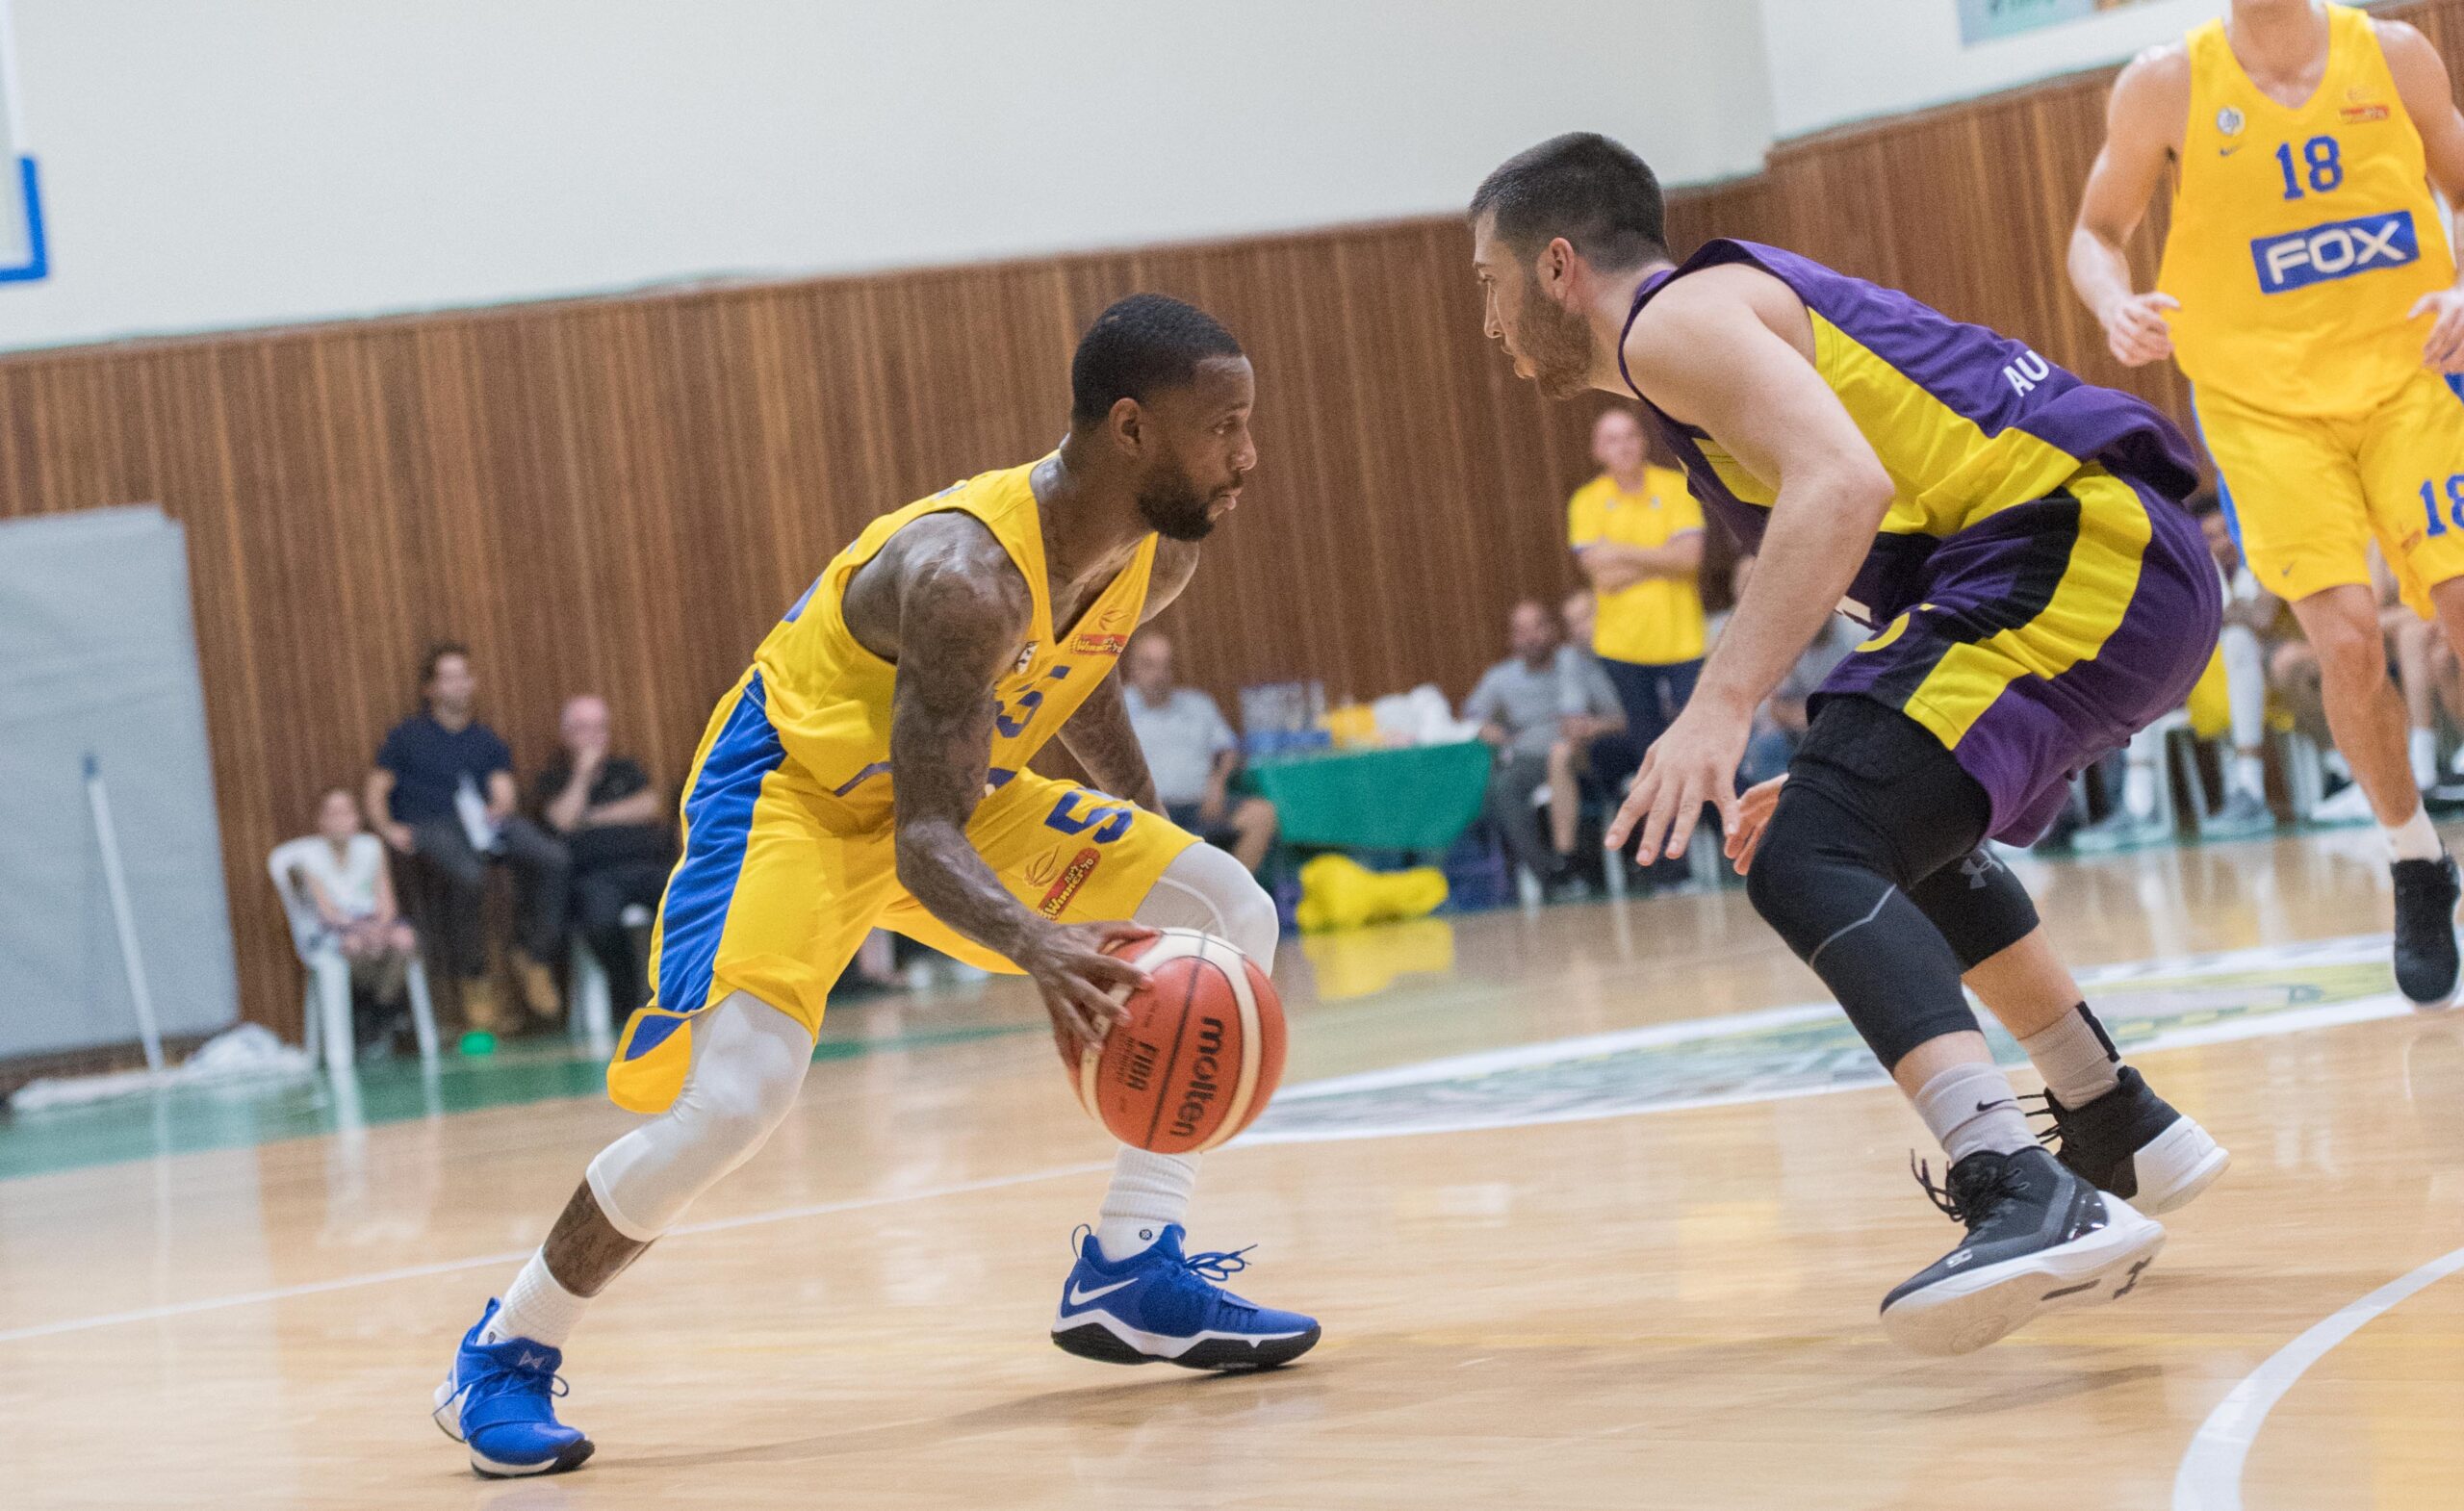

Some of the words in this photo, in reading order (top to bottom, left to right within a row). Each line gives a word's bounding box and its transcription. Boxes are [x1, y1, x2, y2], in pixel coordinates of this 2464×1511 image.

[2275, 135, 2344, 200] 18
[2266, 220, 2406, 285] FOX
[2003, 349, 2049, 397] AU
[1044, 791, 1133, 844] 5
[1044, 868, 1085, 916] Winner
[1126, 1040, 1160, 1091] FIBA
[1169, 1016, 1224, 1137] molten
